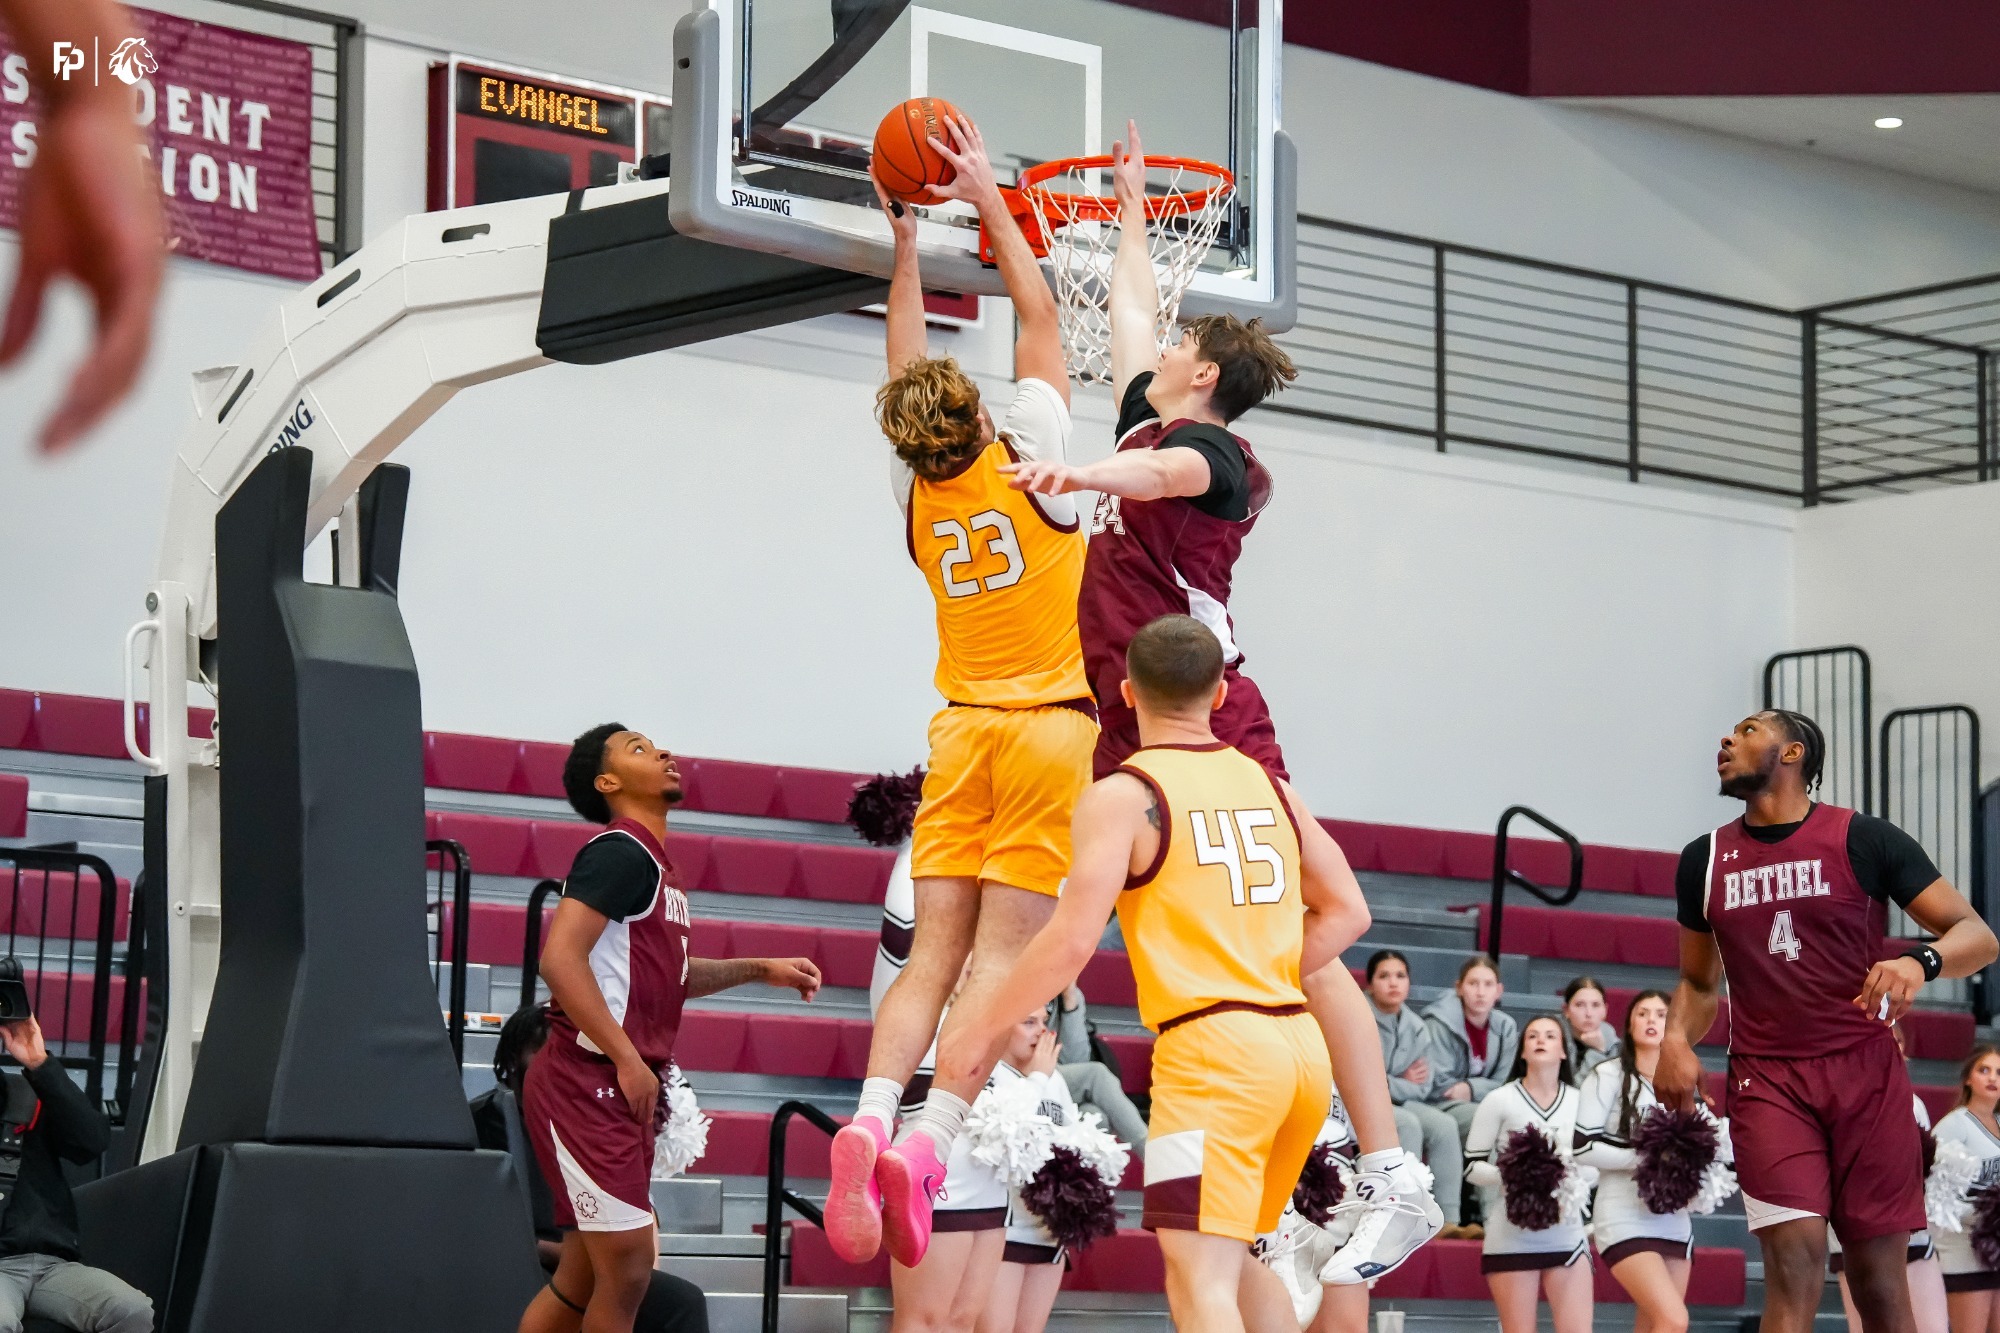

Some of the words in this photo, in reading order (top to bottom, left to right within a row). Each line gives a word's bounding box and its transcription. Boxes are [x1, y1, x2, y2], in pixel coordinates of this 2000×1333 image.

[2, 52, 272, 152] SDENT
[480, 77, 608, 134] EVANGEL
[11, 120, 259, 214] SION
[731, 189, 791, 217] SPALDING
[1090, 491, 1125, 535] 34
[932, 508, 1027, 599] 23
[1189, 807, 1287, 907] 45
[1724, 859, 1831, 911] BETHEL
[1768, 909, 1802, 962] 4
